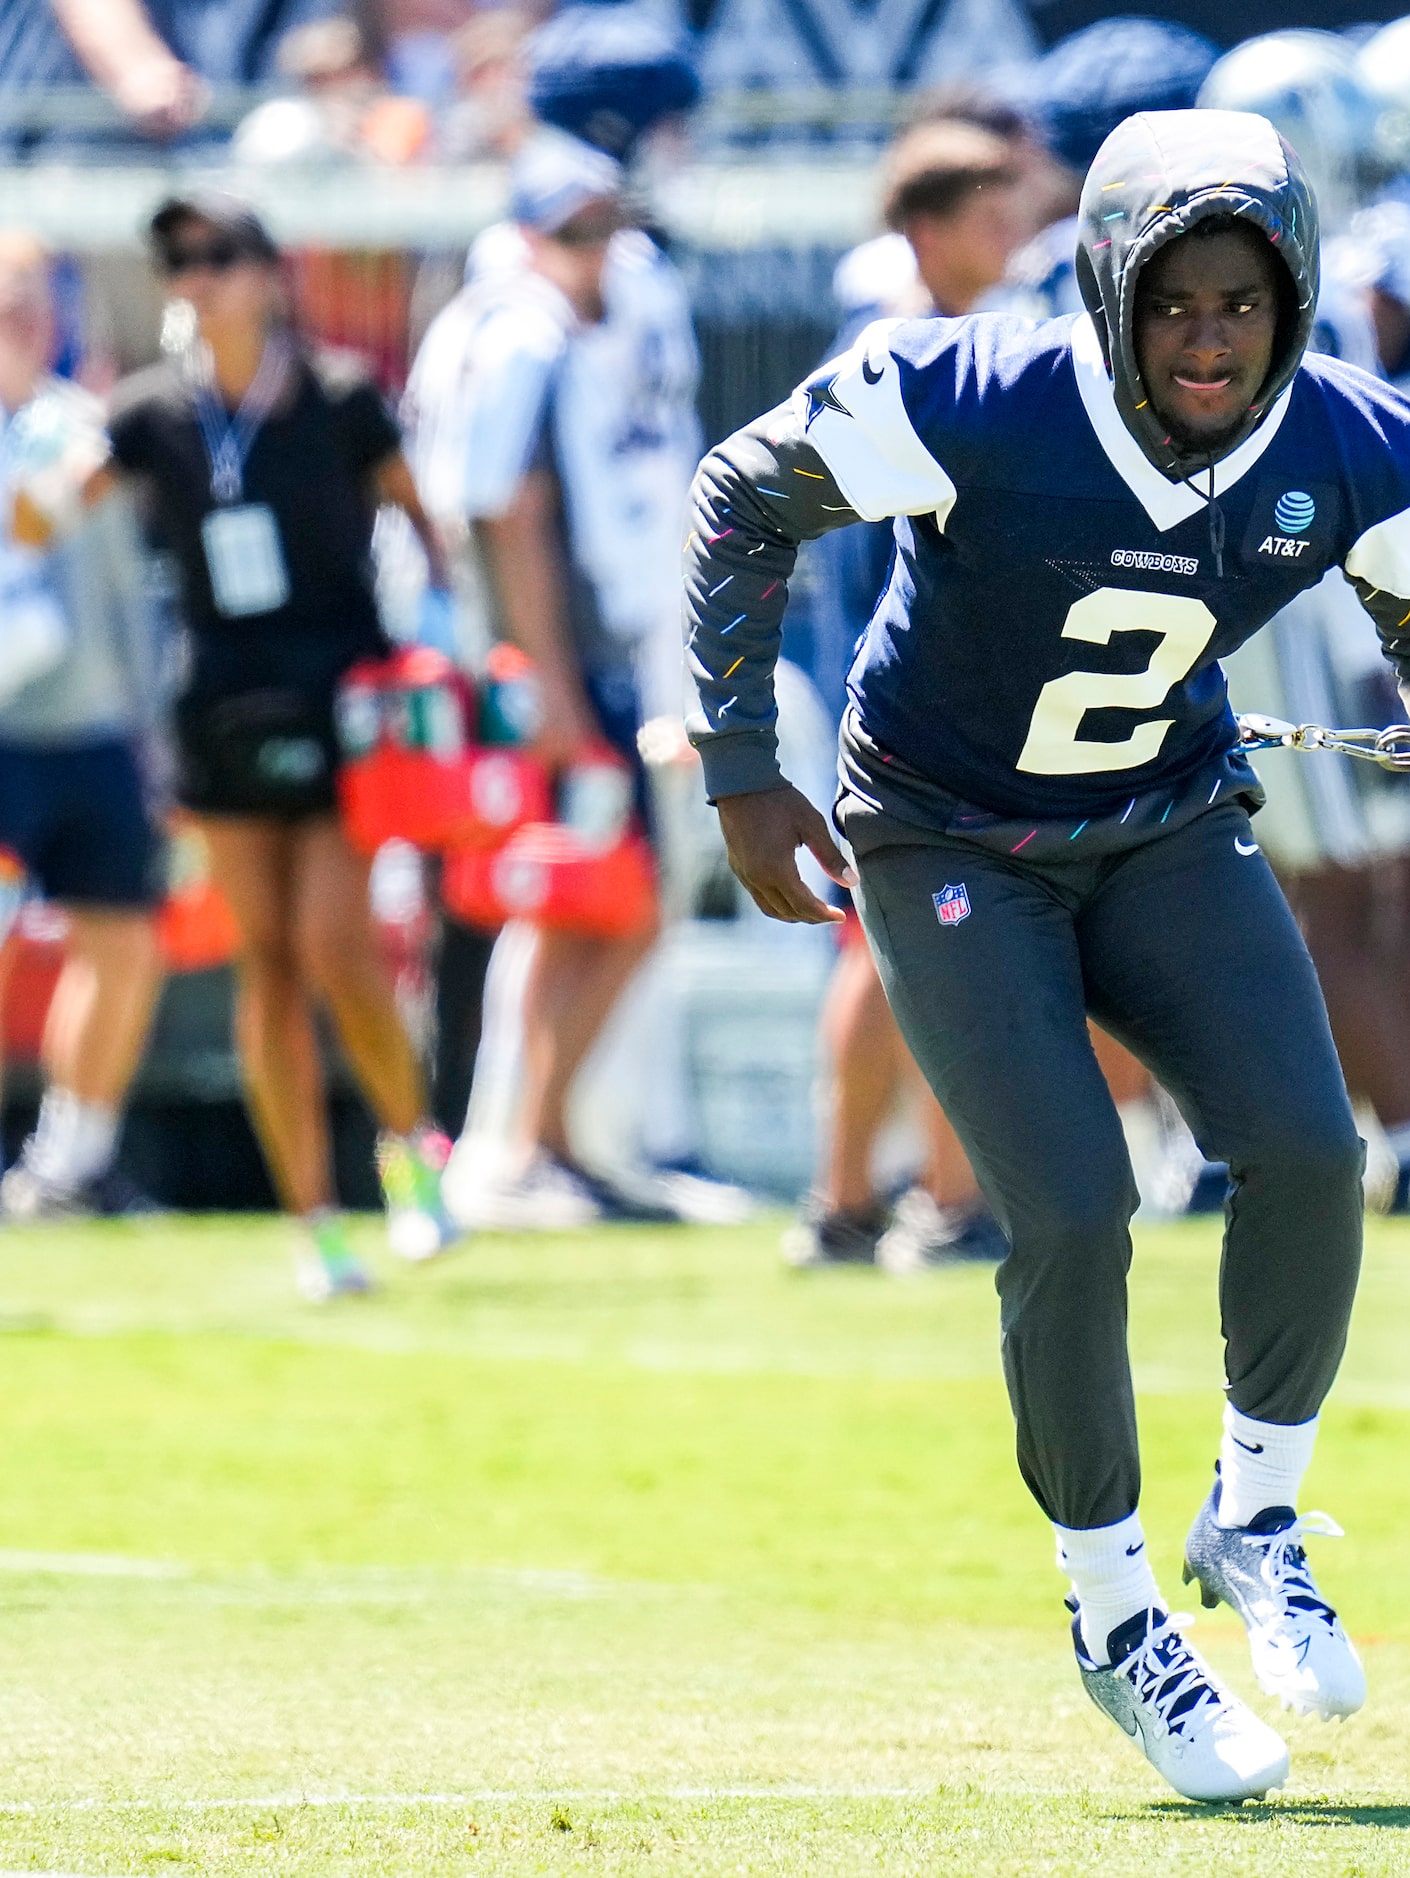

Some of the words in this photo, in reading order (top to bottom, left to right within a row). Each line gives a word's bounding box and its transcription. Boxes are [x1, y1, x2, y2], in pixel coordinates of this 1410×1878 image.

[1257, 536, 1311, 558] AT&T
[1111, 549, 1199, 576] COWBOYS
[1015, 586, 1218, 775] 2
[940, 899, 968, 921] NFL
